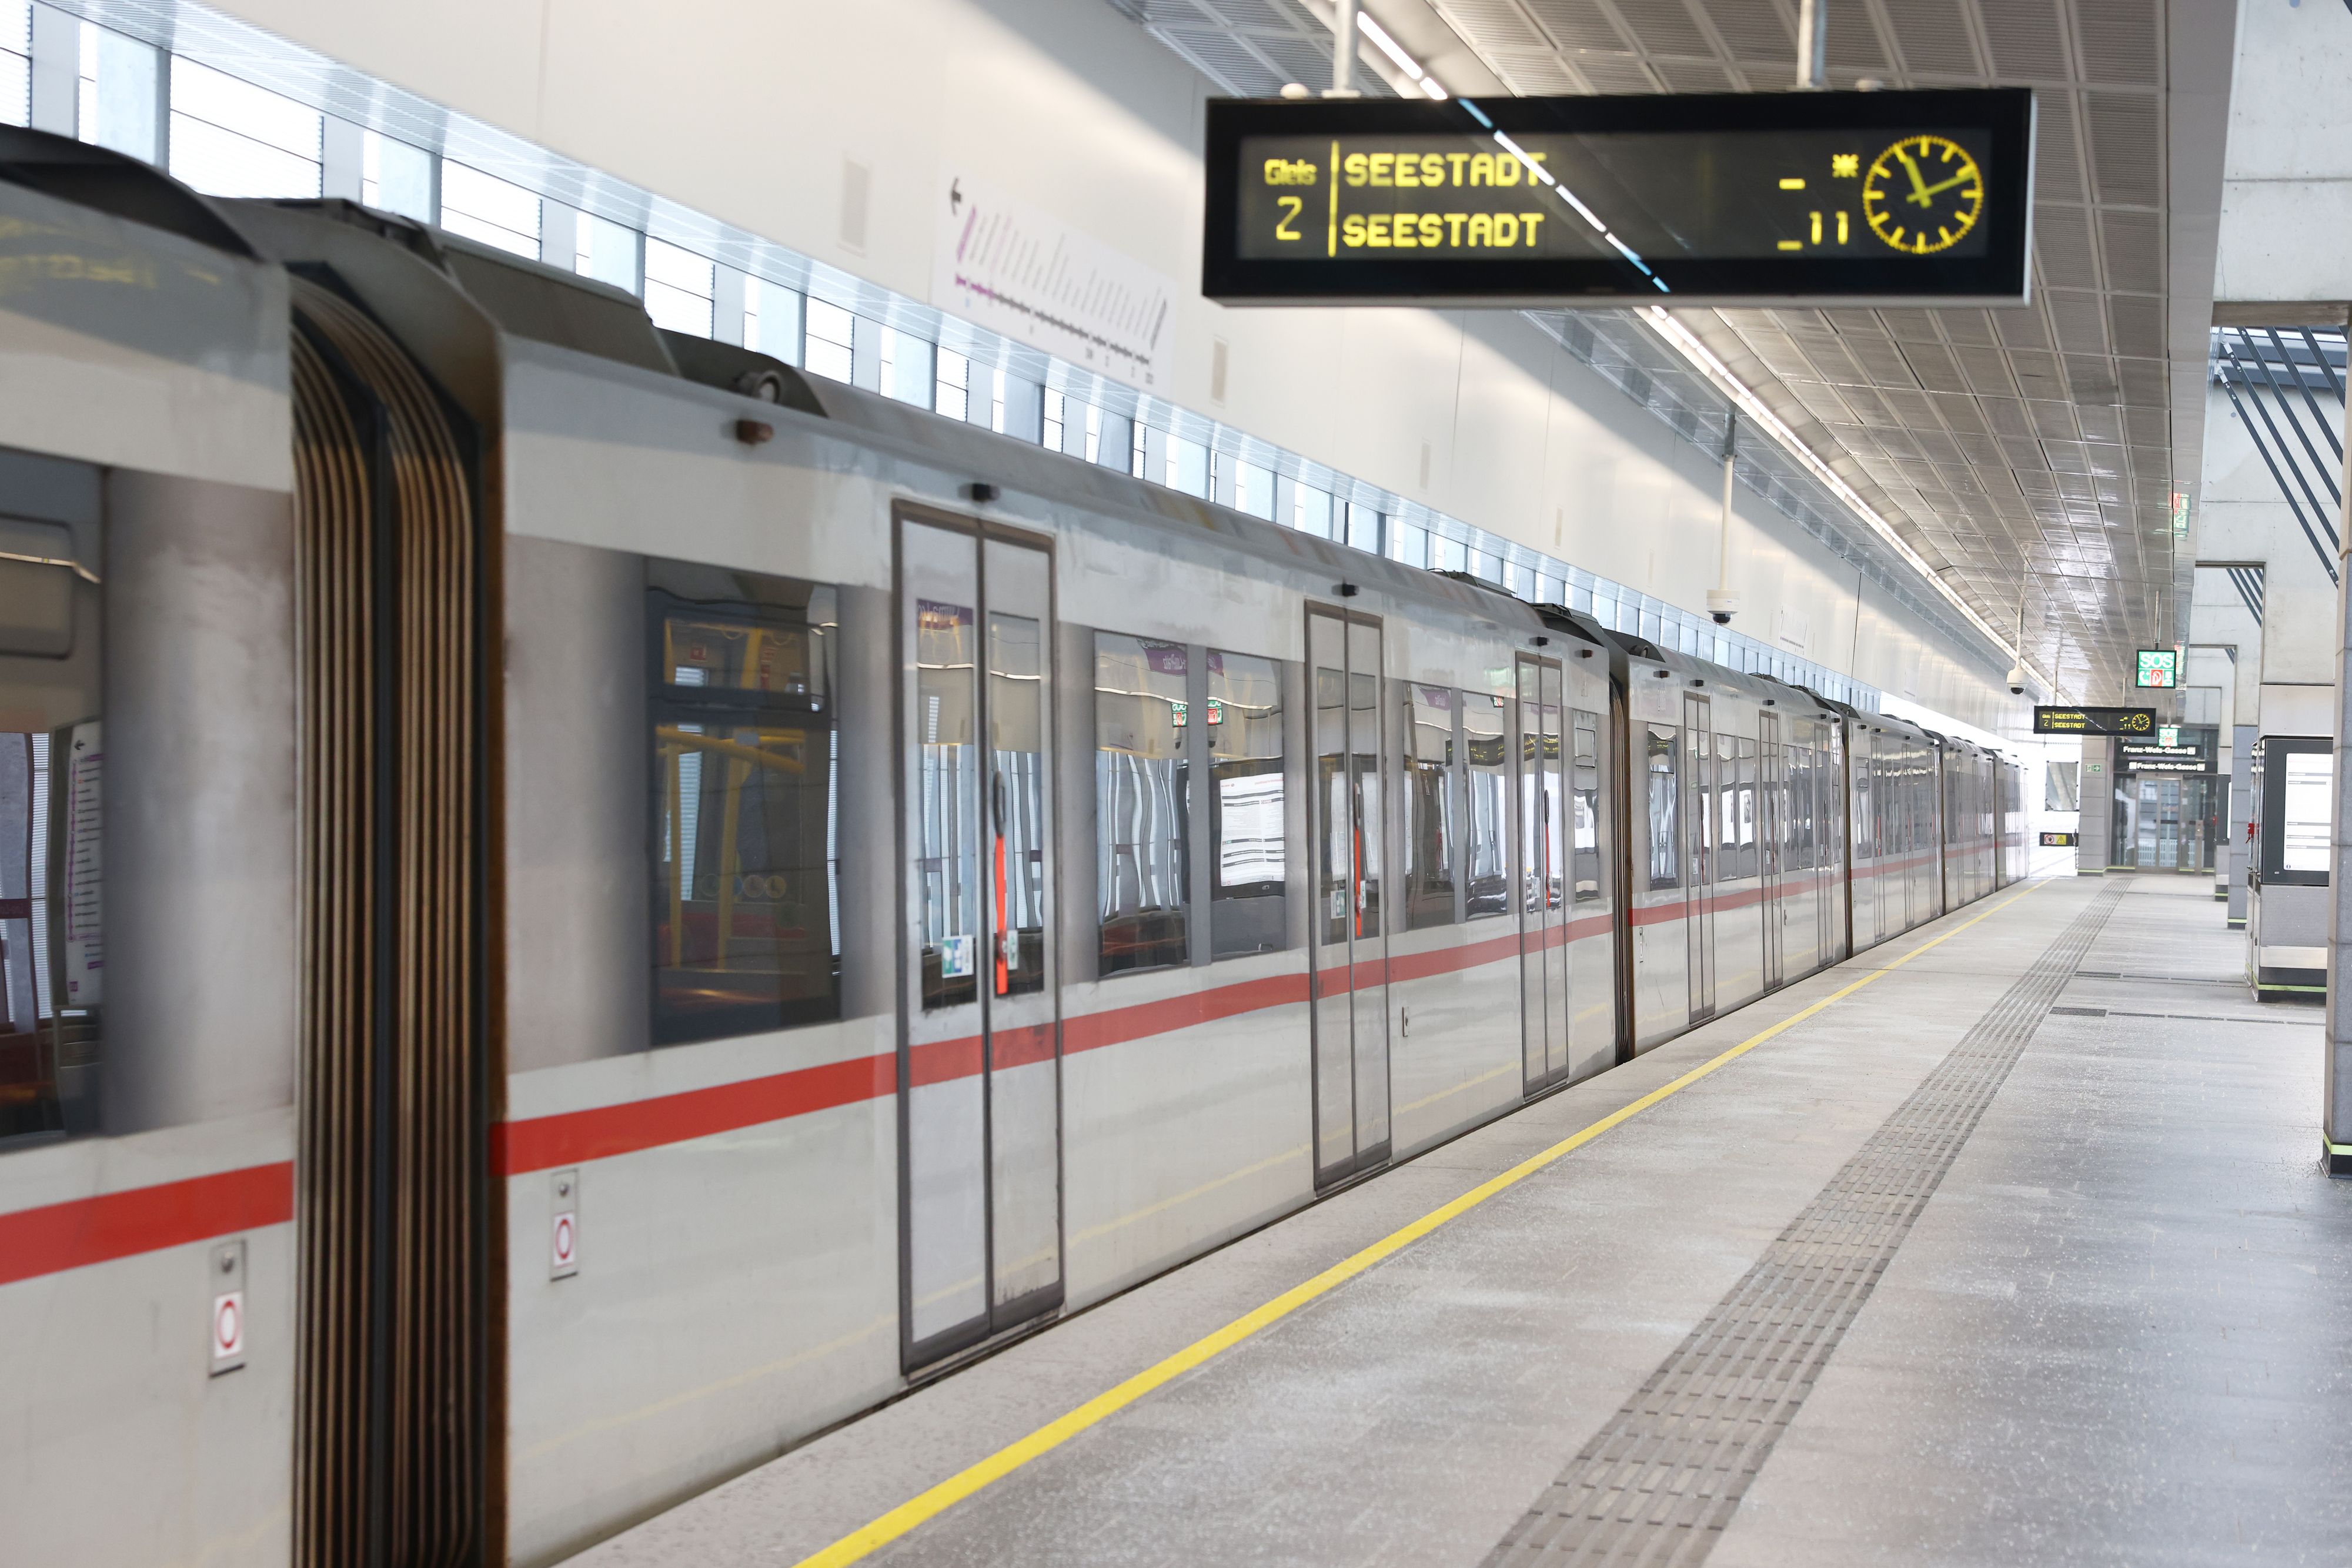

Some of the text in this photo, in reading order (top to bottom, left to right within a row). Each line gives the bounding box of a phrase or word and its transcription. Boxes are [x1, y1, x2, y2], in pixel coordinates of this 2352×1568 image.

[1264, 158, 1318, 186] Gleis
[1344, 152, 1548, 188] SEESTADT
[1275, 196, 1303, 240] 2
[1342, 213, 1546, 249] SEESTADT
[2140, 653, 2174, 668] SOS
